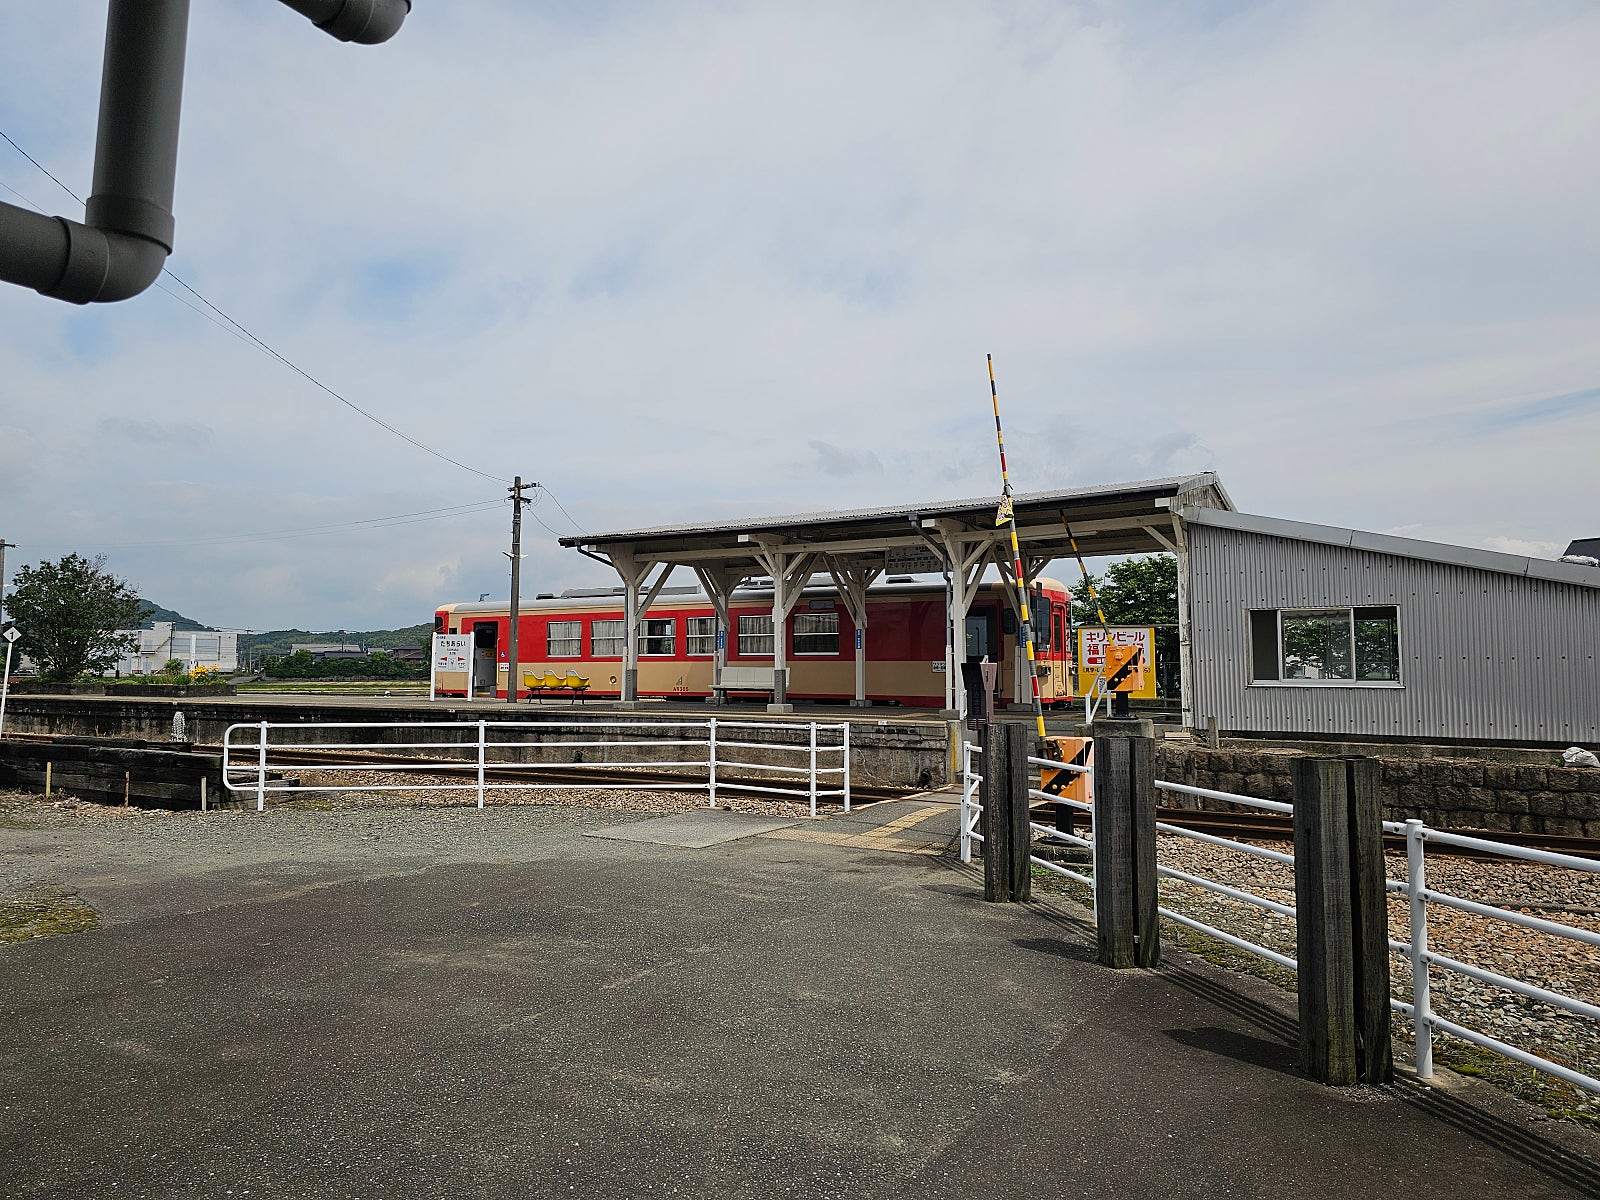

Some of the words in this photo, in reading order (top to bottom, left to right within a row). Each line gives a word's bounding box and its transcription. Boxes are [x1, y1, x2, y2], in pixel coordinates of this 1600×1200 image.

[9, 631, 14, 640] 1
[440, 640, 466, 648] たちあらい
